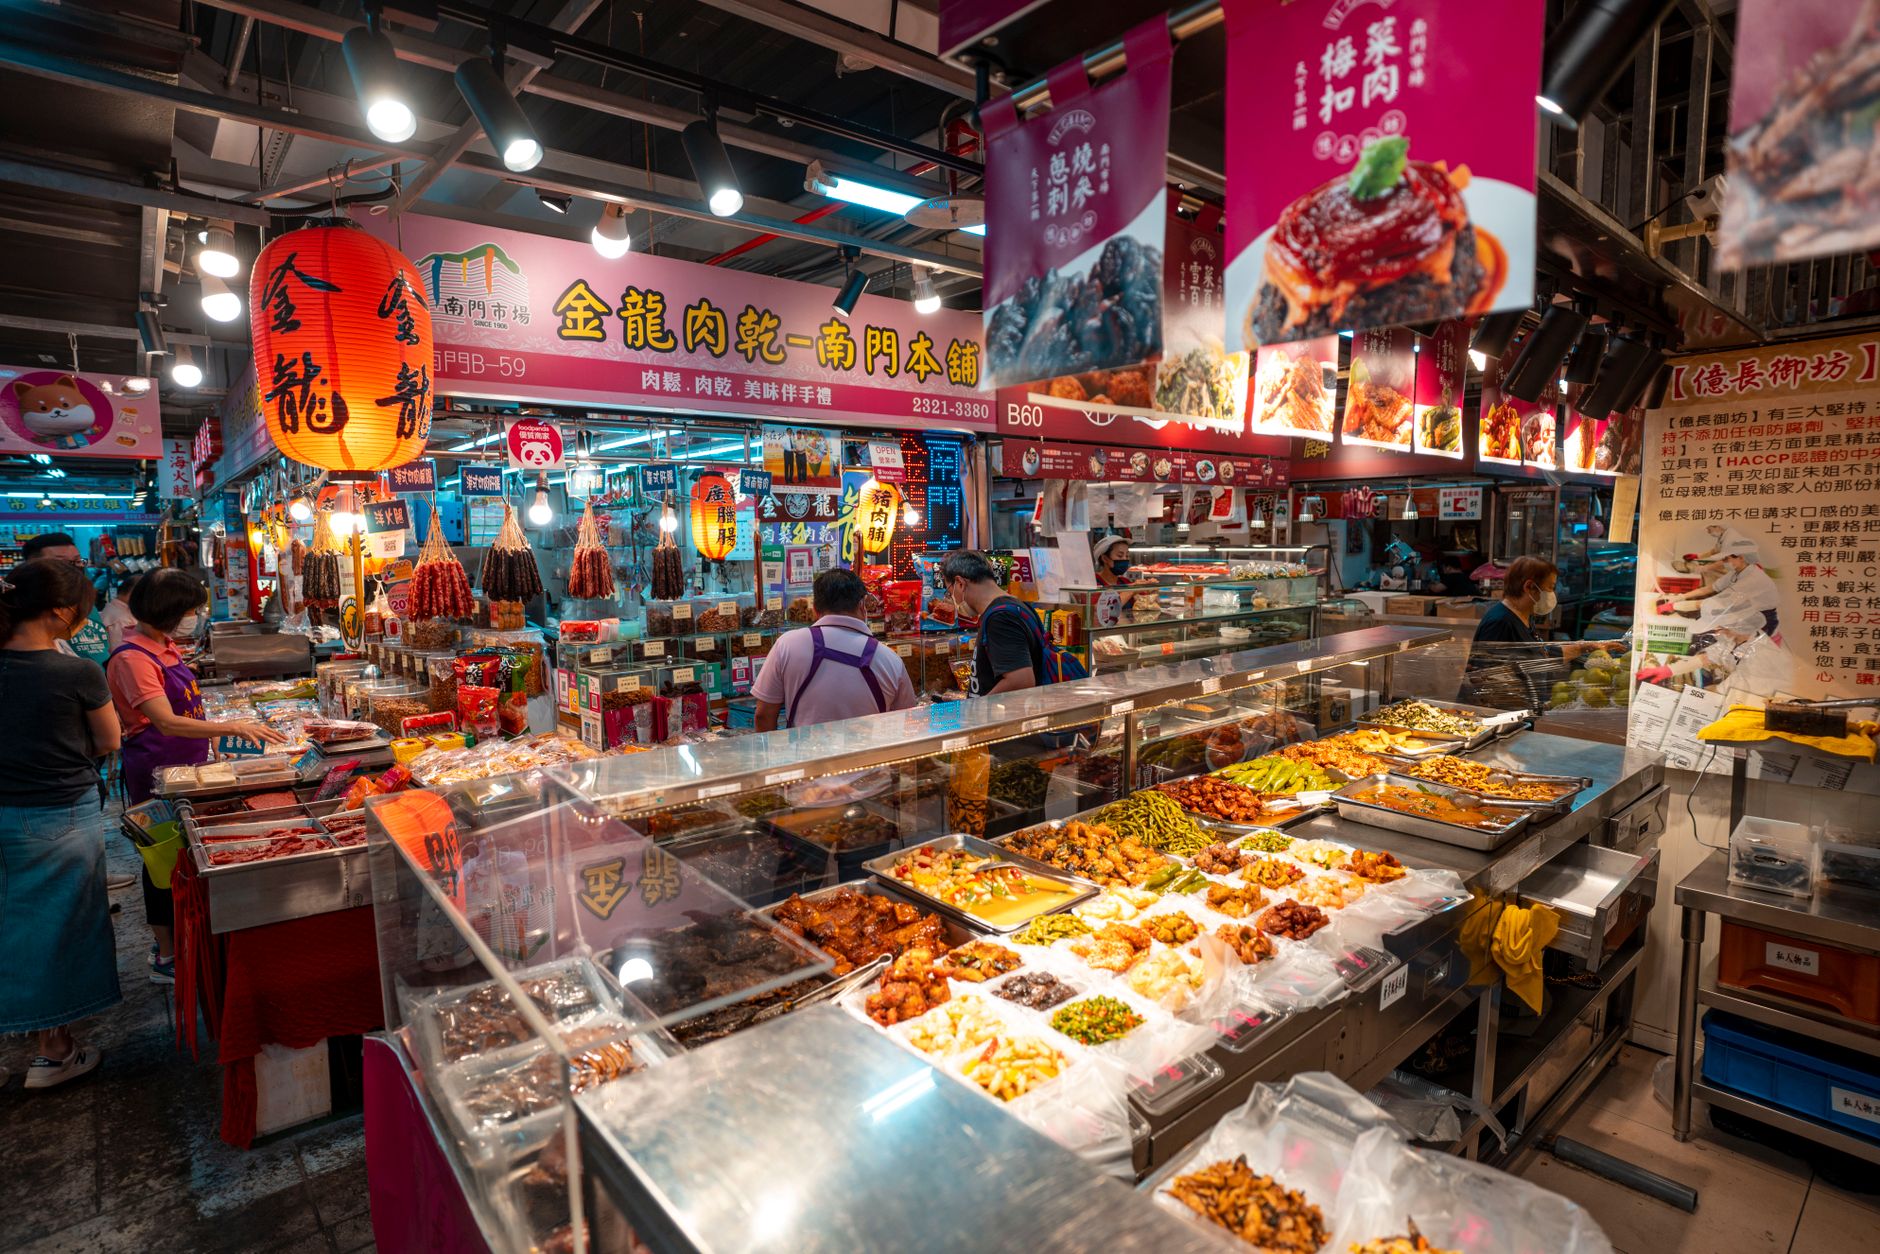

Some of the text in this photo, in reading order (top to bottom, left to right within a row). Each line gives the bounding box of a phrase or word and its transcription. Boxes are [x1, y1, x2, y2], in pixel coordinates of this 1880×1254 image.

[444, 296, 531, 325] 南門市場
[912, 396, 989, 420] 2321-3380
[1007, 403, 1043, 427] B60
[518, 424, 550, 432] foodpanda
[876, 446, 896, 455] OPEN
[169, 441, 192, 498] 上海火腿
[1659, 504, 1880, 521] 億長御坊不但講求口感的美
[1796, 550, 1880, 563] 食材則嚴
[1690, 689, 1705, 699] SGS
[1776, 951, 1811, 967] 私人物品
